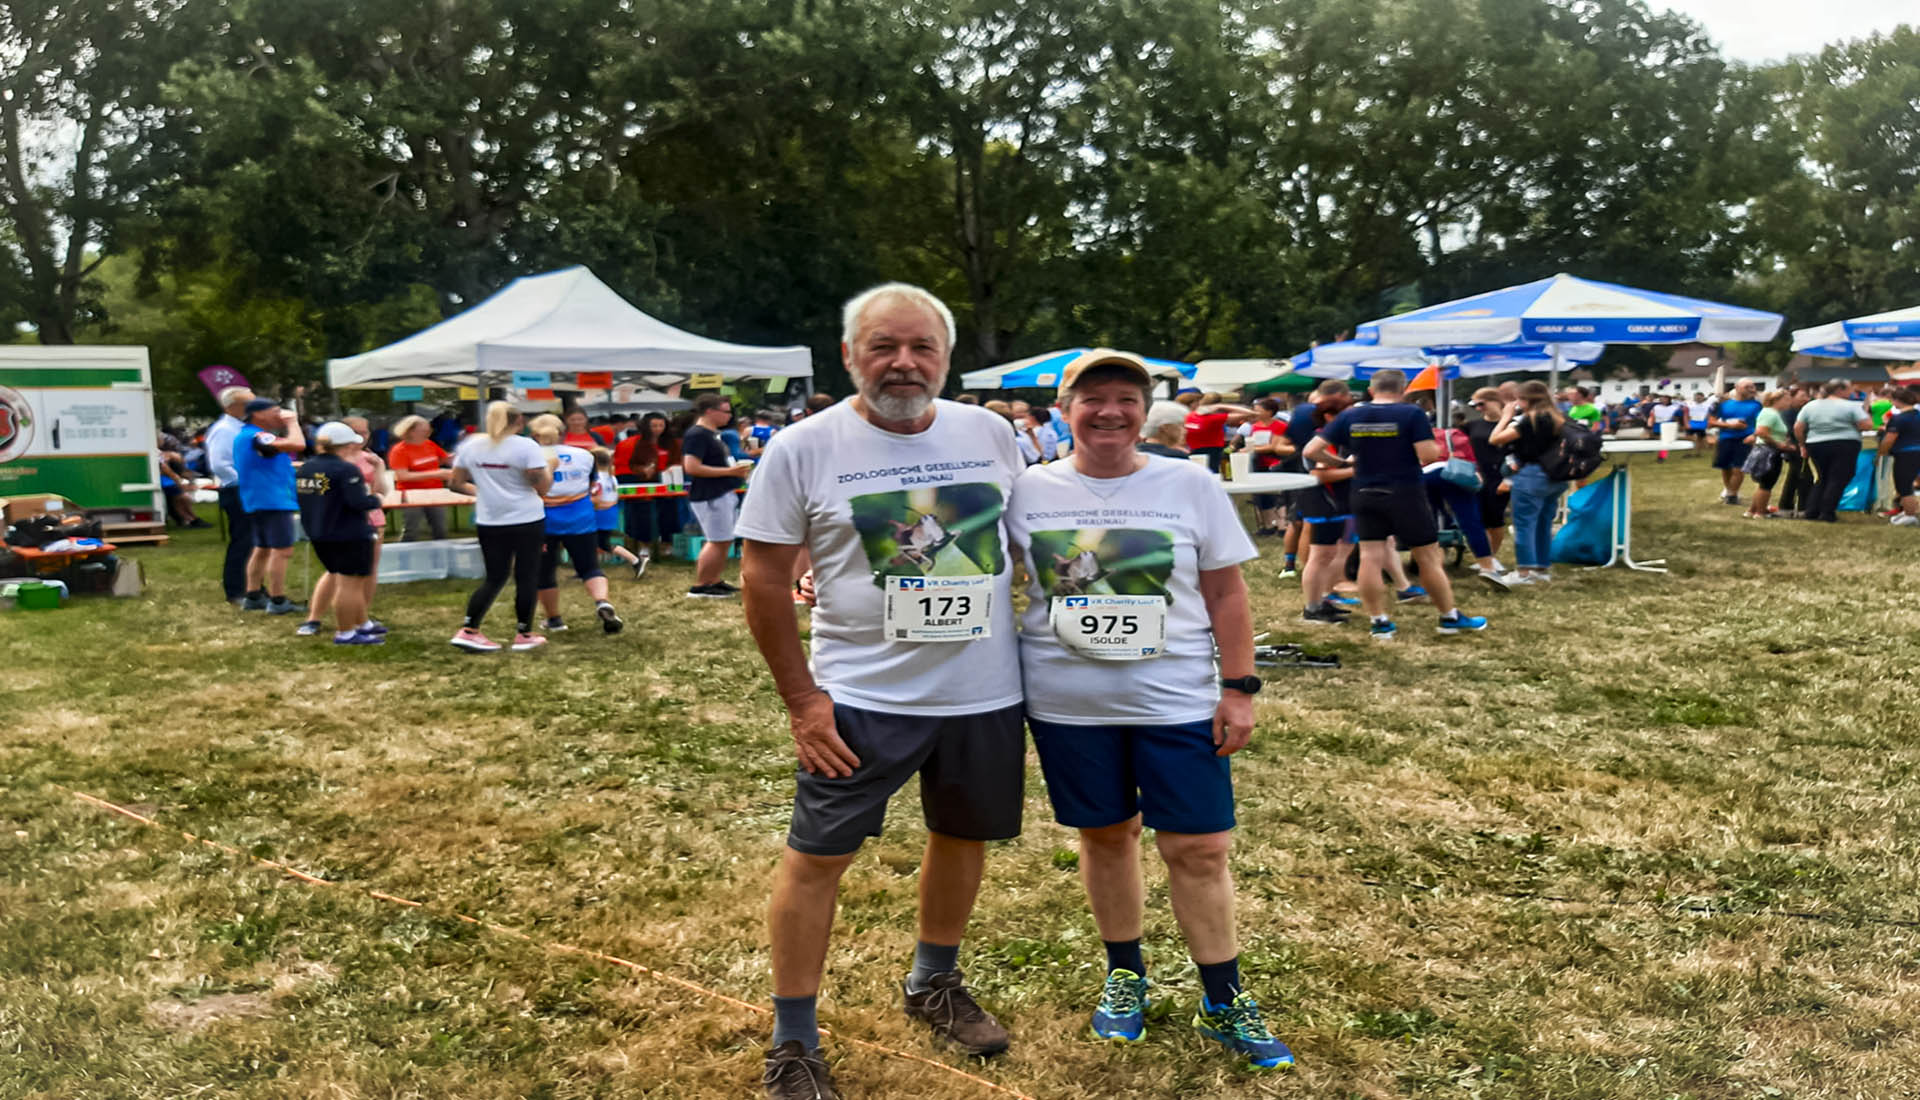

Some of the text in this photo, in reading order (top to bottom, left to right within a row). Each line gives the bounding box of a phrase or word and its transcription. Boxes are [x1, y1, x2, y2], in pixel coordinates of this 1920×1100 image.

[837, 464, 922, 484] ZOOLOGISCHE
[900, 473, 954, 486] BRAUNAU
[1026, 509, 1181, 521] ZOOLOGISCHE GESELLSCHAFT
[1075, 518, 1127, 526] BRAUNAU
[918, 596, 971, 616] 173
[924, 618, 963, 626] ALBERT
[1080, 615, 1138, 634] 975
[1090, 637, 1128, 645] ISOLDE
